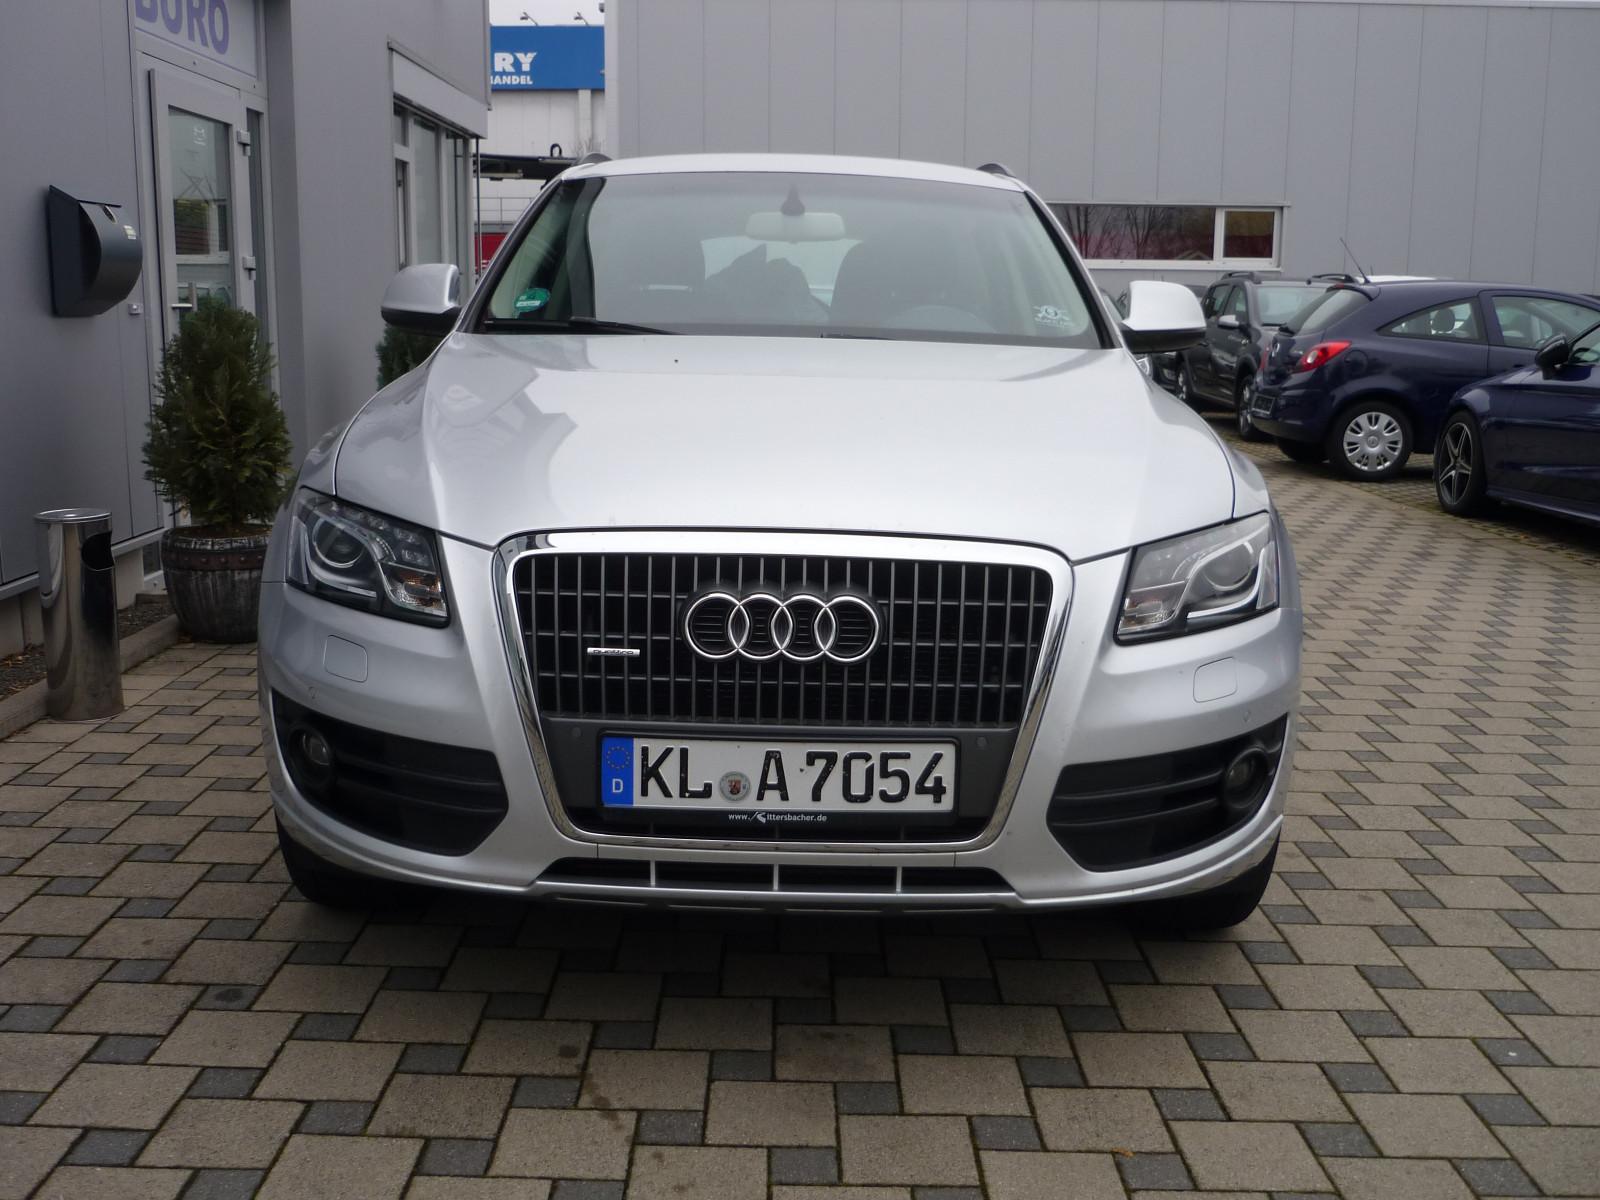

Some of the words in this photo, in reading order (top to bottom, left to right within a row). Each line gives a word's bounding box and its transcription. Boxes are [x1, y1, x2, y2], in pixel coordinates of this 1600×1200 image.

[612, 778, 624, 793] D
[640, 746, 712, 798] KL
[756, 750, 789, 801] A
[806, 751, 947, 803] 7054
